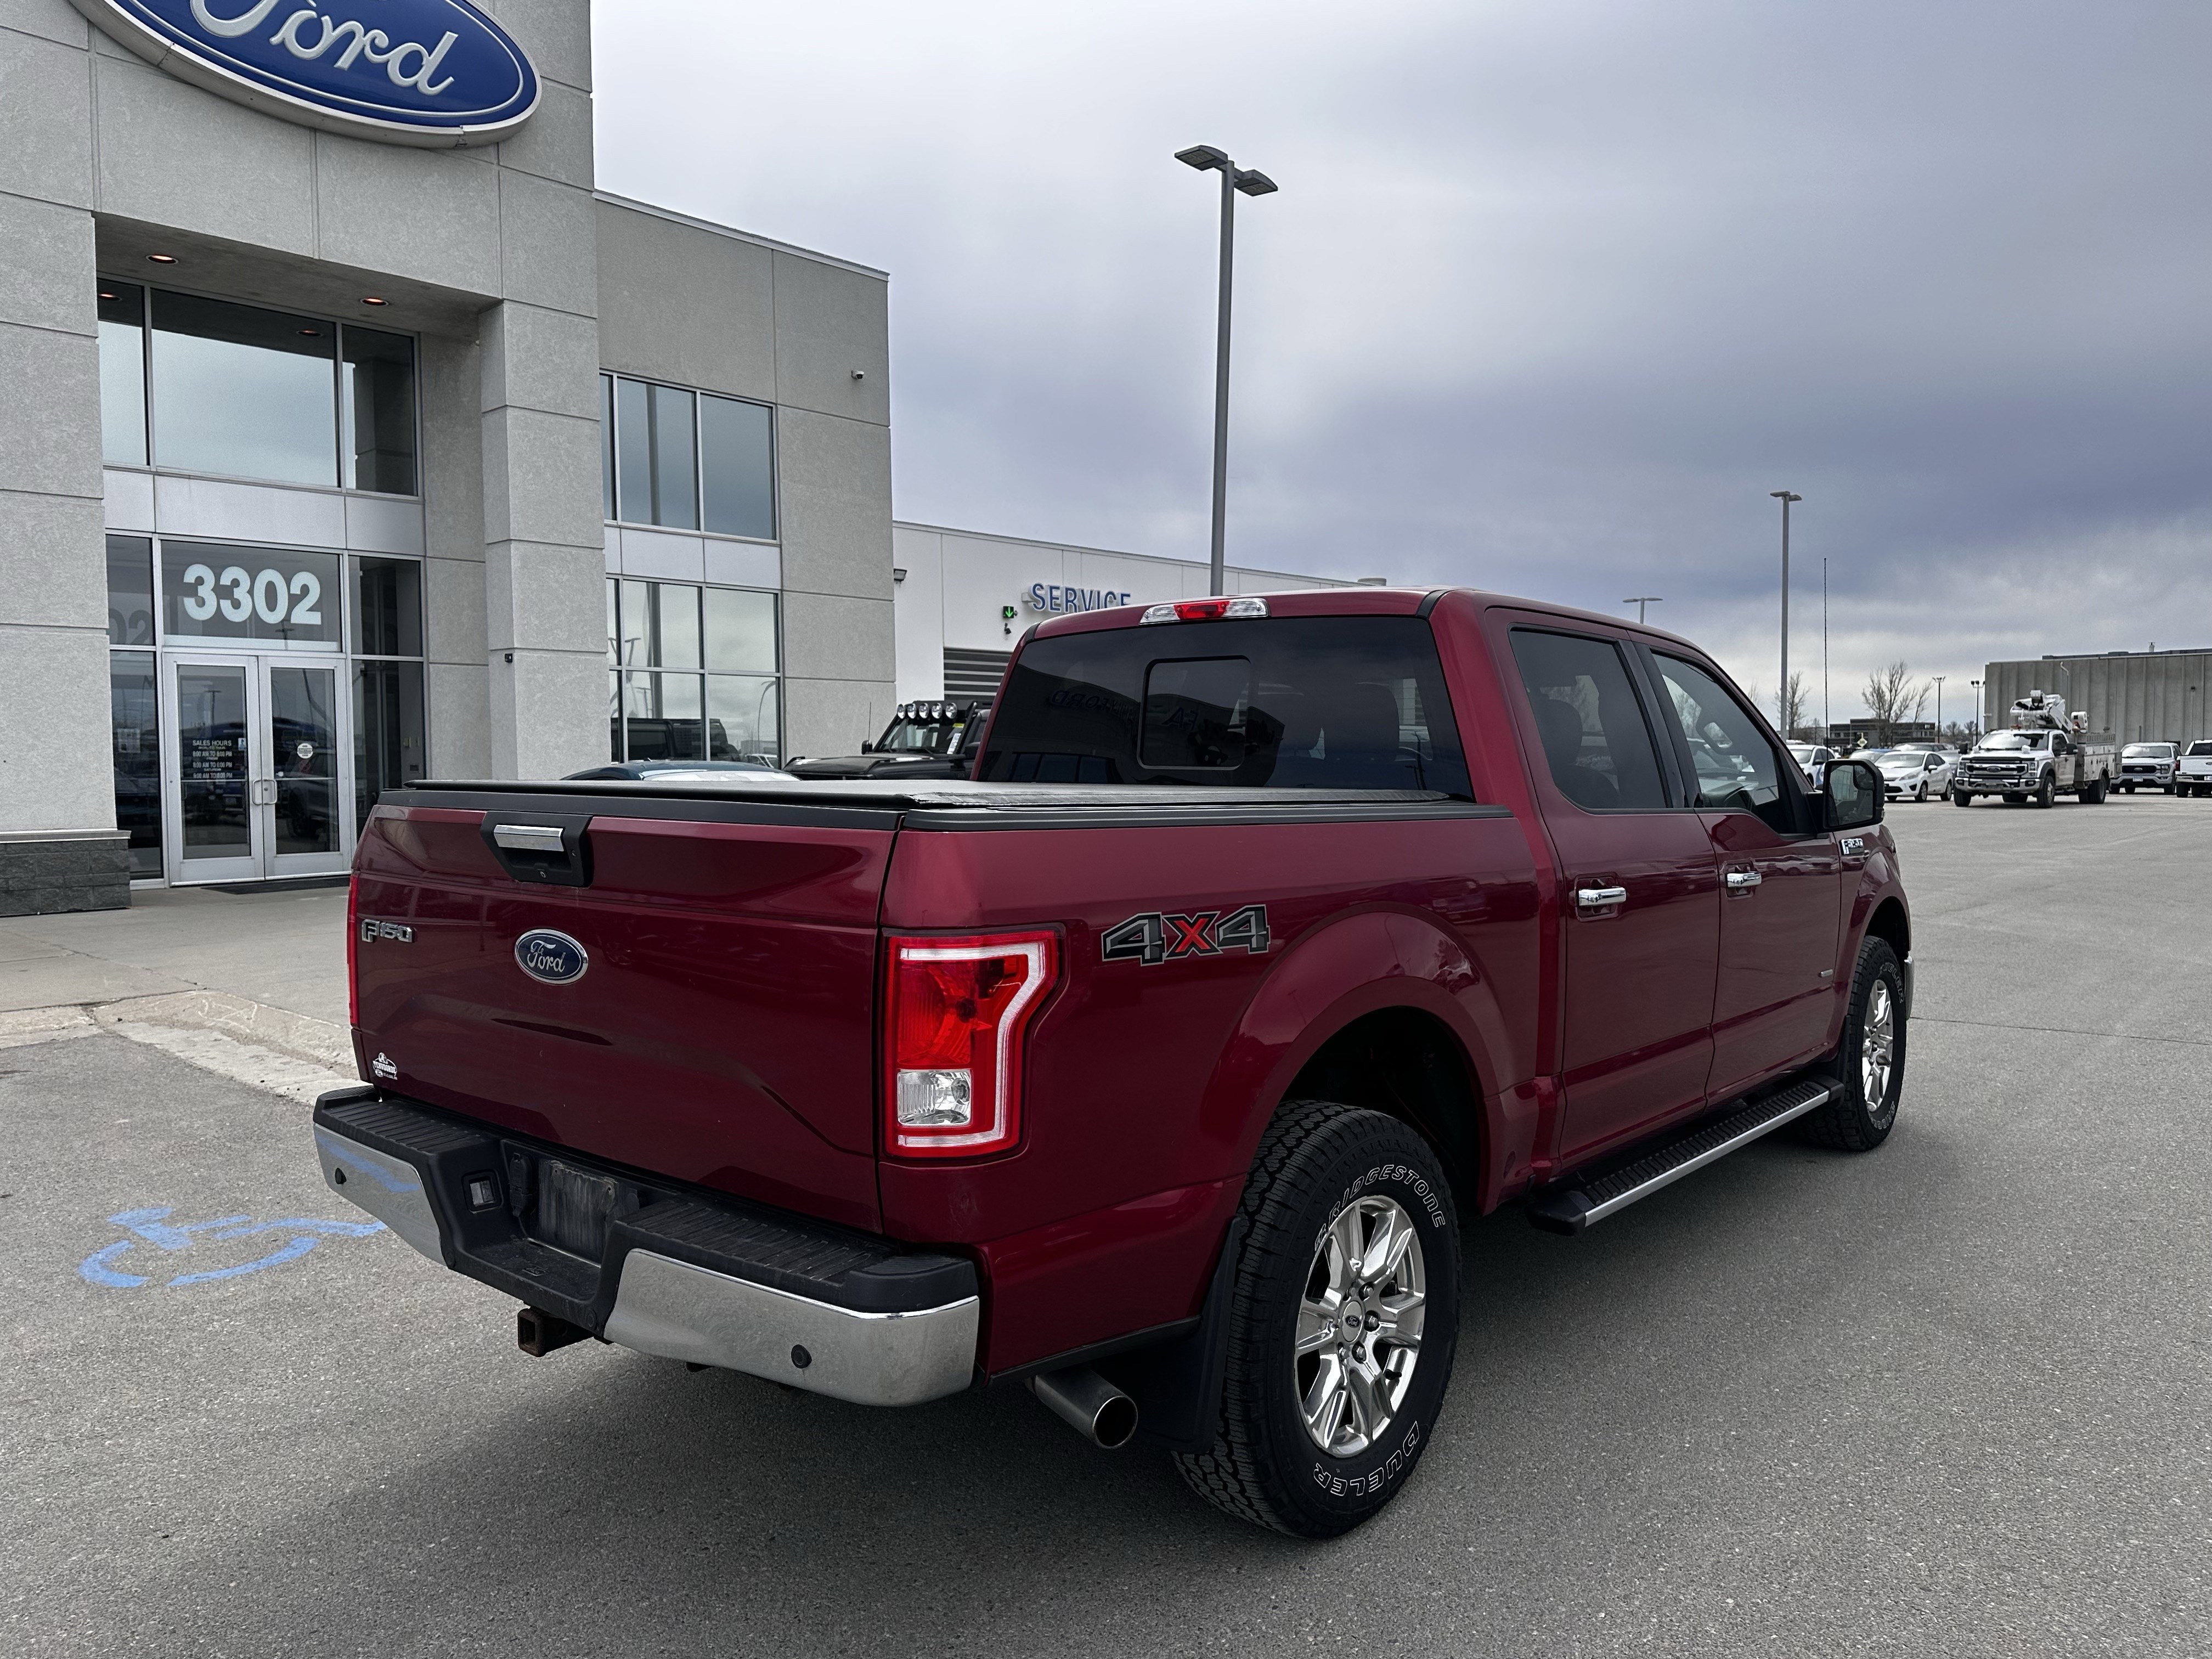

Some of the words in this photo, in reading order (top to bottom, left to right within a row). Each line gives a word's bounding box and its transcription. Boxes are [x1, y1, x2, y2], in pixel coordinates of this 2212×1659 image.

[183, 564, 321, 625] 3302
[1031, 583, 1131, 613] SERVICE
[527, 940, 566, 973] Ford
[1314, 1164, 1446, 1252] BRIDGESTONE
[1313, 1420, 1420, 1497] DUELER
